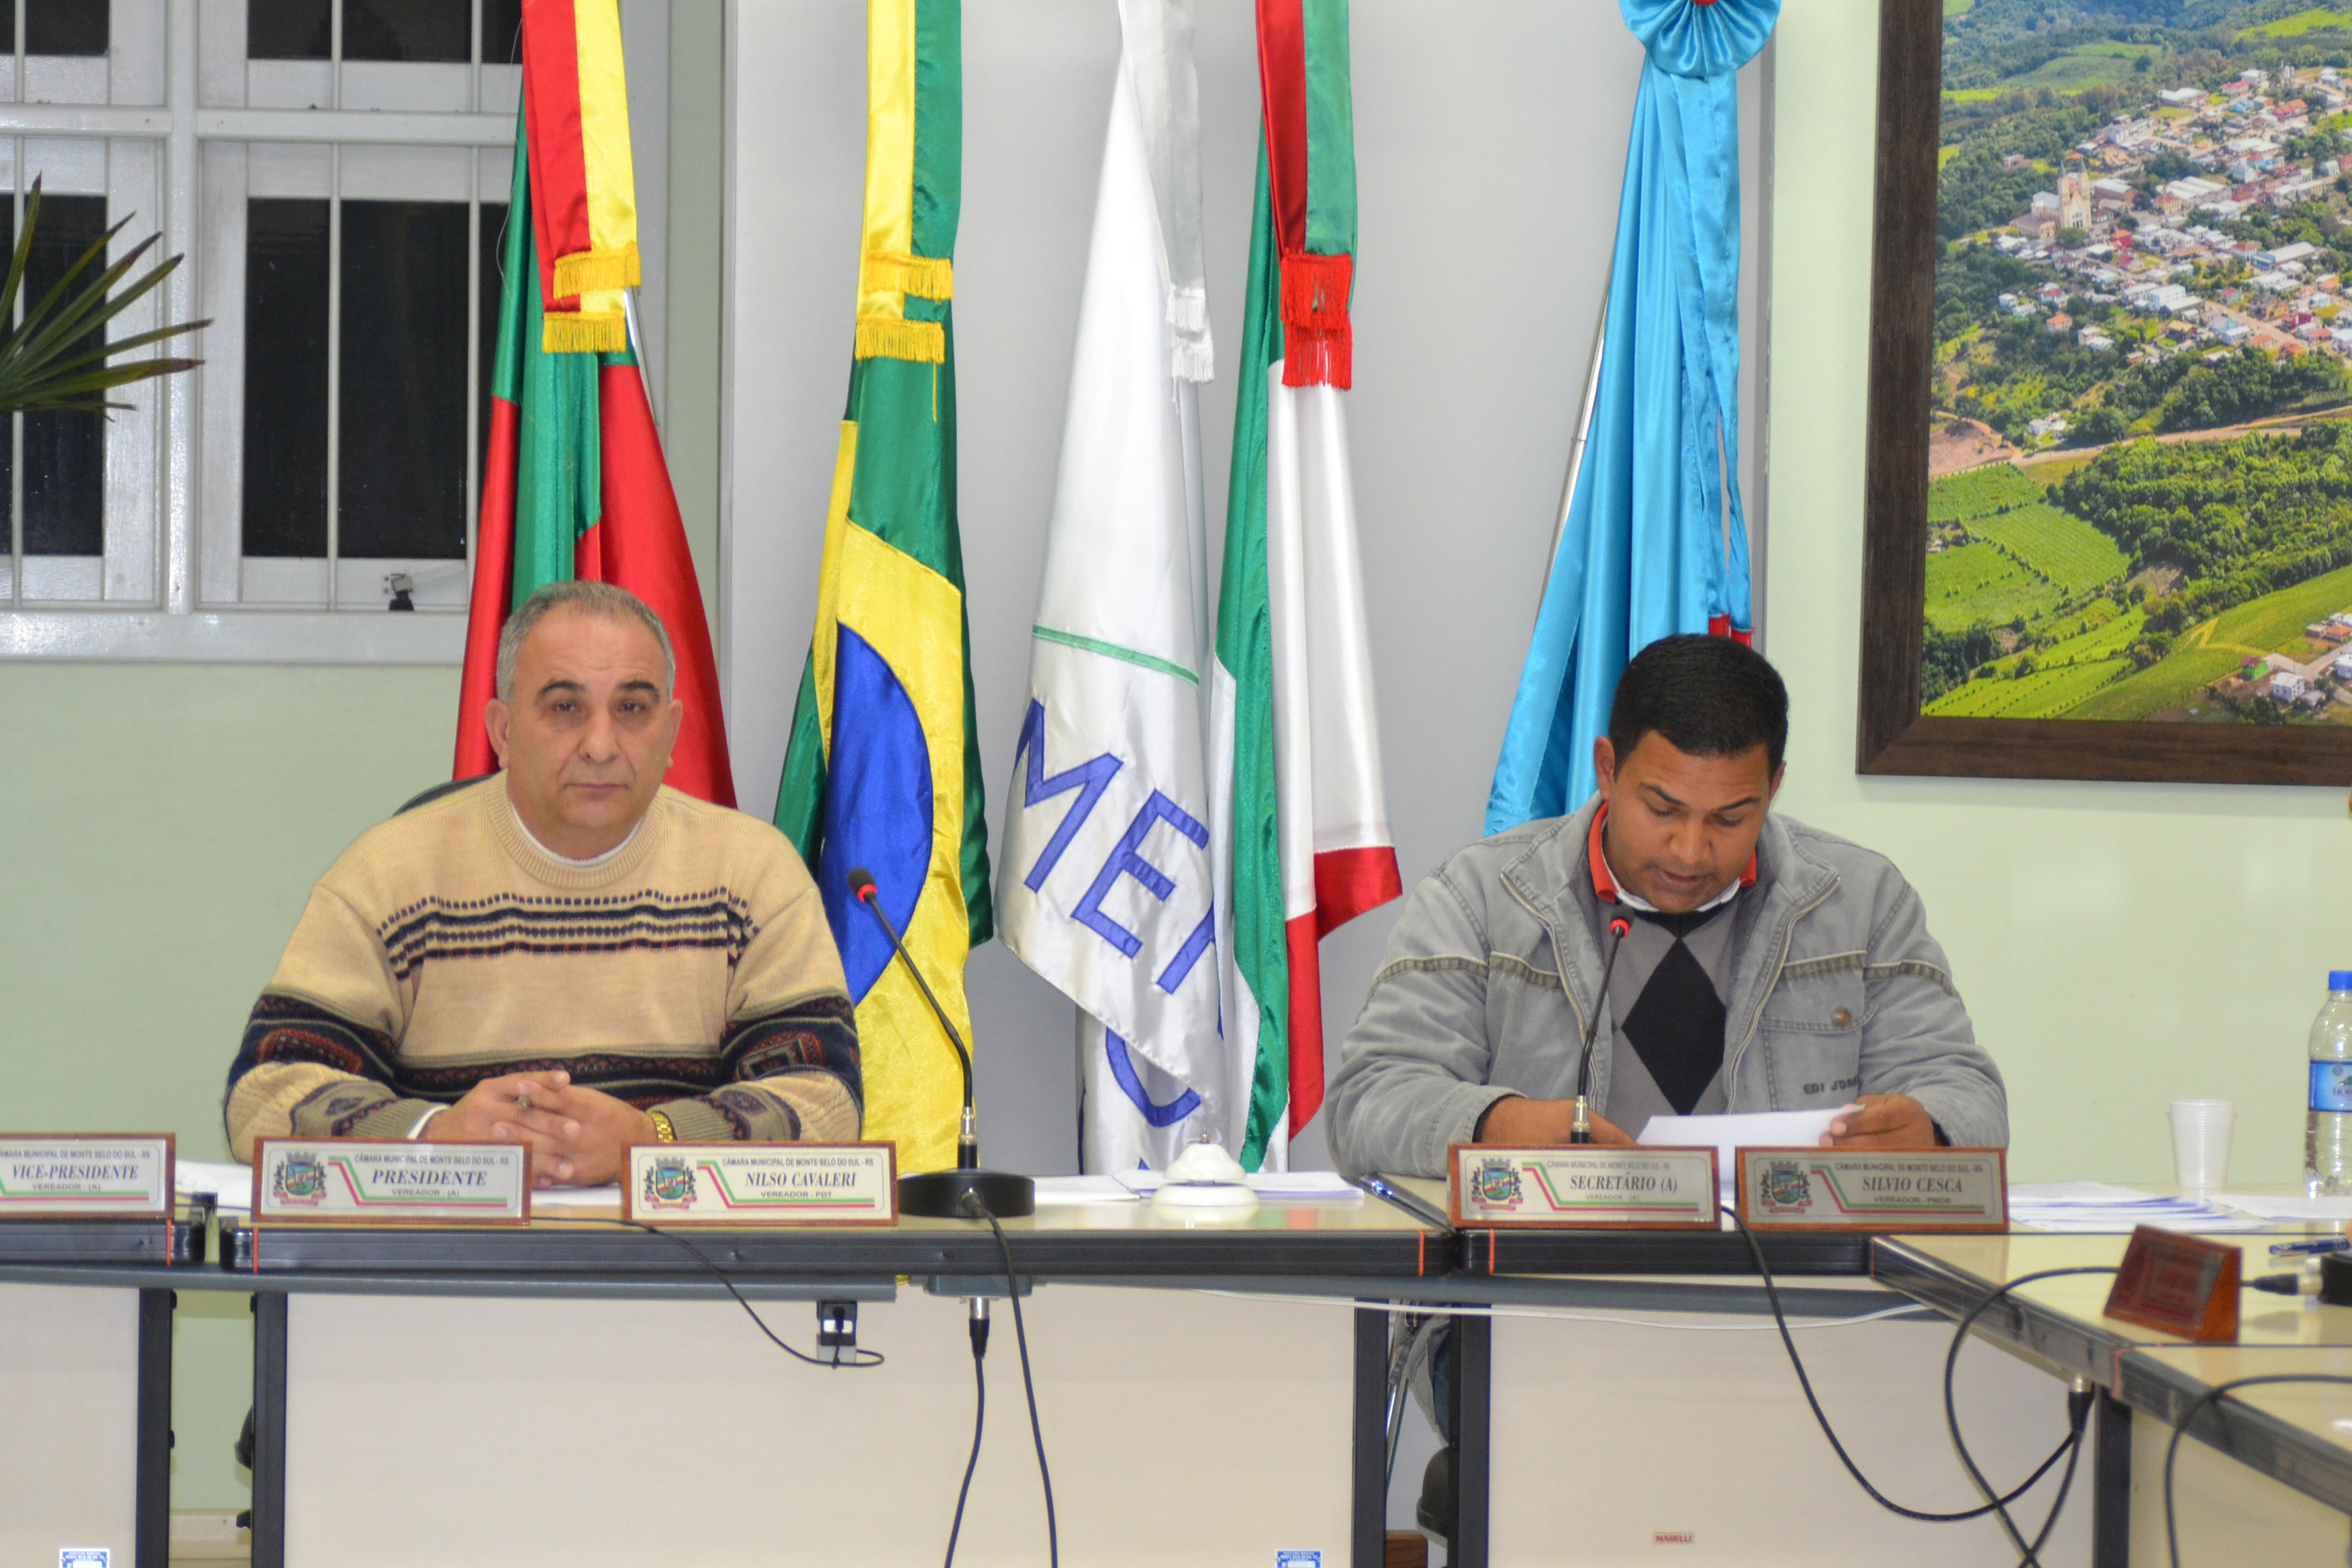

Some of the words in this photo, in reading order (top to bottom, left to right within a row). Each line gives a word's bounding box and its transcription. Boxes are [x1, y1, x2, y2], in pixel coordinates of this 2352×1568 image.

[0, 1149, 22, 1158] ÂMARA
[23, 1149, 58, 1158] MUNICIPAL
[355, 1154, 382, 1163] CÂMARA
[383, 1156, 418, 1164] MUNICIPAL
[429, 1156, 452, 1164] MONTE
[453, 1156, 471, 1164] BELO
[722, 1157, 749, 1166] CÂMARA
[751, 1158, 783, 1166] MUNICIPAL
[1835, 1162, 1863, 1171] CÂMARA
[1863, 1163, 1896, 1171] MUNICIPAL
[1908, 1164, 1929, 1172] MONTE
[1930, 1164, 1946, 1172] BELO
[12, 1164, 139, 1179] VICE-PRESIDENTE
[372, 1169, 487, 1186] PRESIDENTE
[746, 1172, 787, 1187] NILSO
[792, 1172, 857, 1187] CAVALERI
[1570, 1172, 1656, 1190] SECRETÁRIO
[1661, 1178, 1678, 1194] (A)
[1863, 1177, 1912, 1192] SILVIO
[1917, 1178, 1963, 1192] CESCA
[447, 1189, 459, 1197] (A)
